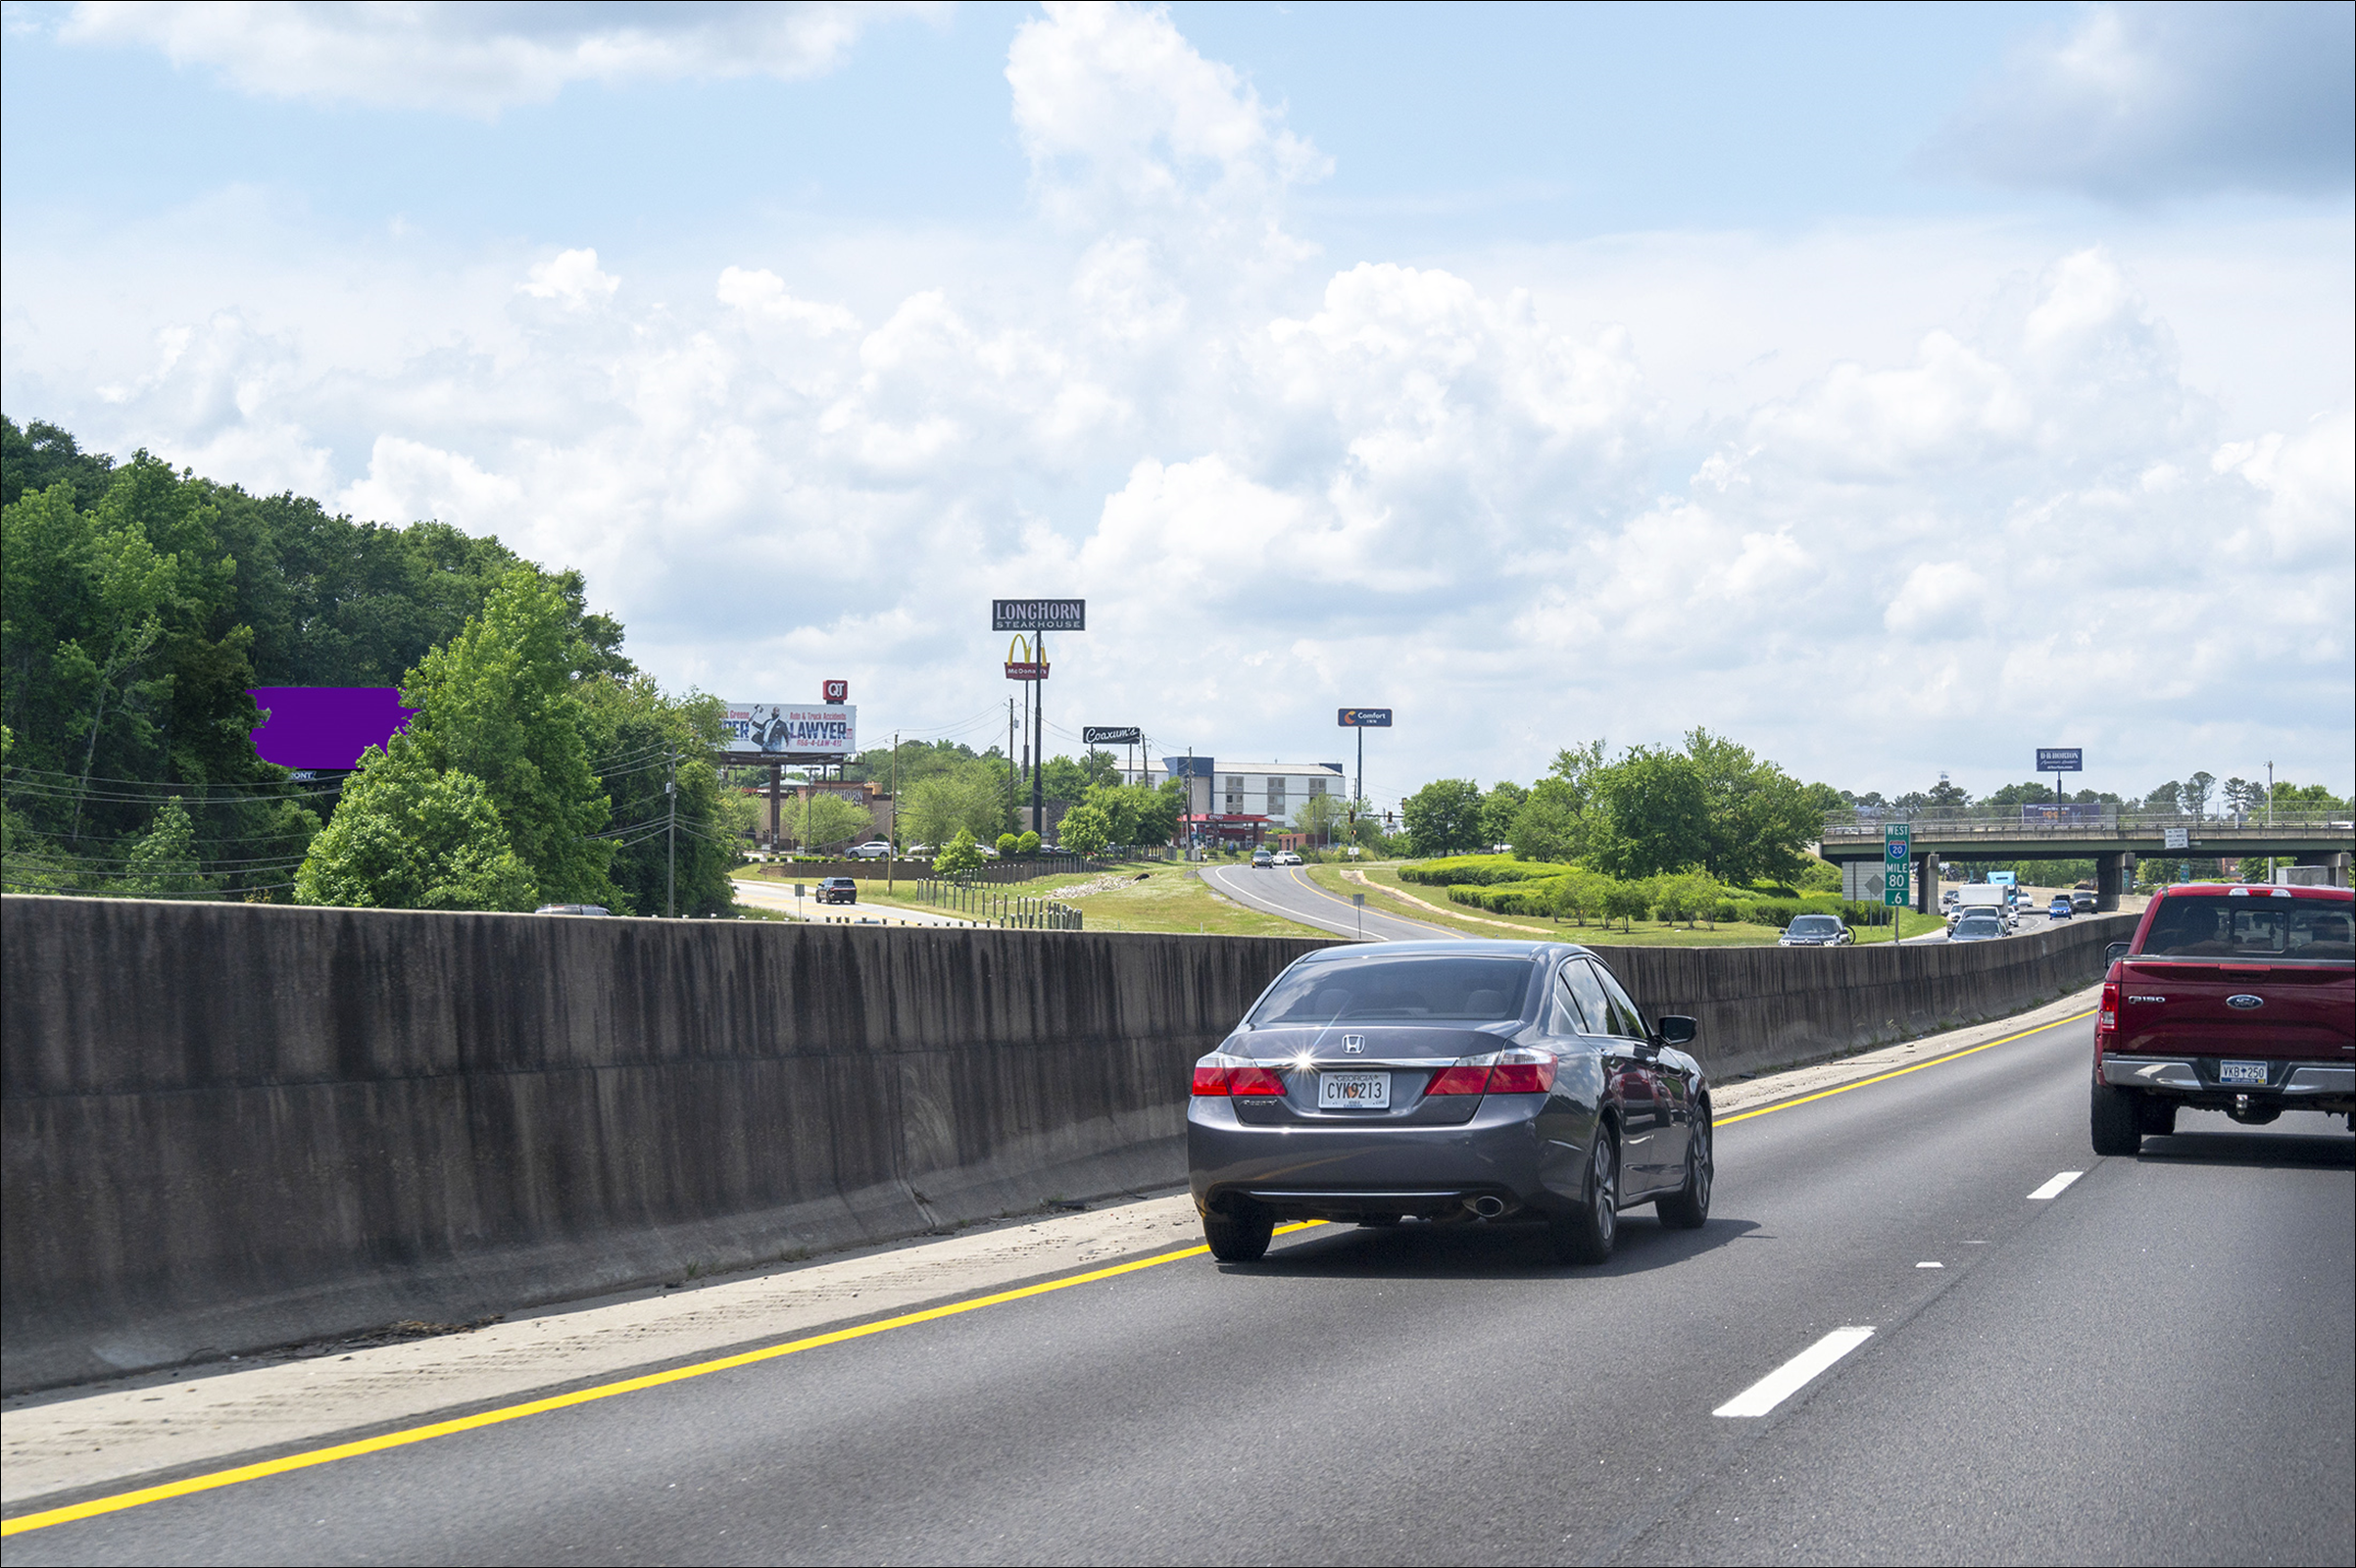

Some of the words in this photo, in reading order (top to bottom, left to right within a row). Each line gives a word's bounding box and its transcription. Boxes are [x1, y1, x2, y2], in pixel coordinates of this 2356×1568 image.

[997, 603, 1081, 619] LONGHORN
[828, 683, 844, 697] QT
[790, 721, 847, 739] LAWYER
[1086, 727, 1138, 743] Coaxum's
[1888, 825, 1908, 835] WEST
[1892, 846, 1903, 855] 20
[1887, 863, 1907, 873] MILE
[1889, 874, 1904, 887] 80
[1891, 892, 1902, 905] .6
[1327, 1082, 1382, 1099] CYK9213
